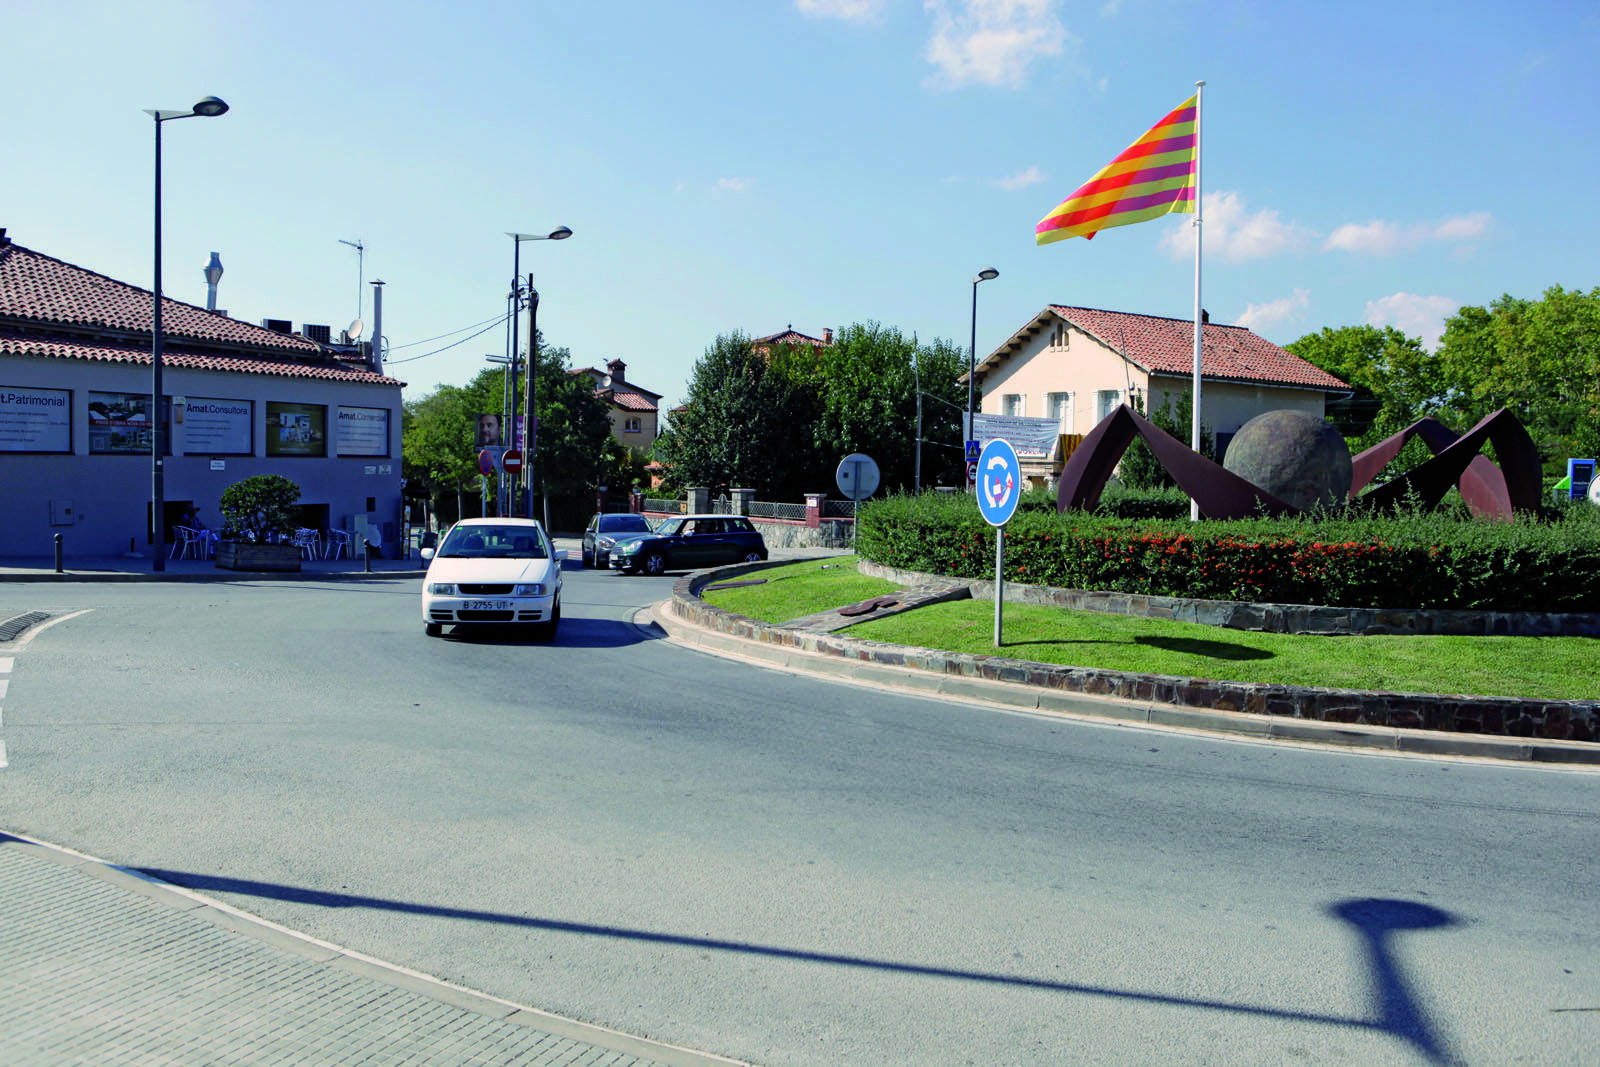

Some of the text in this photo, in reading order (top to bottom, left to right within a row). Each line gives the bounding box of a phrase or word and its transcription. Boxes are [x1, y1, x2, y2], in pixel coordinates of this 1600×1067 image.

[186, 403, 248, 415] Amat.Consultora
[463, 601, 507, 609] B 2755 UT
